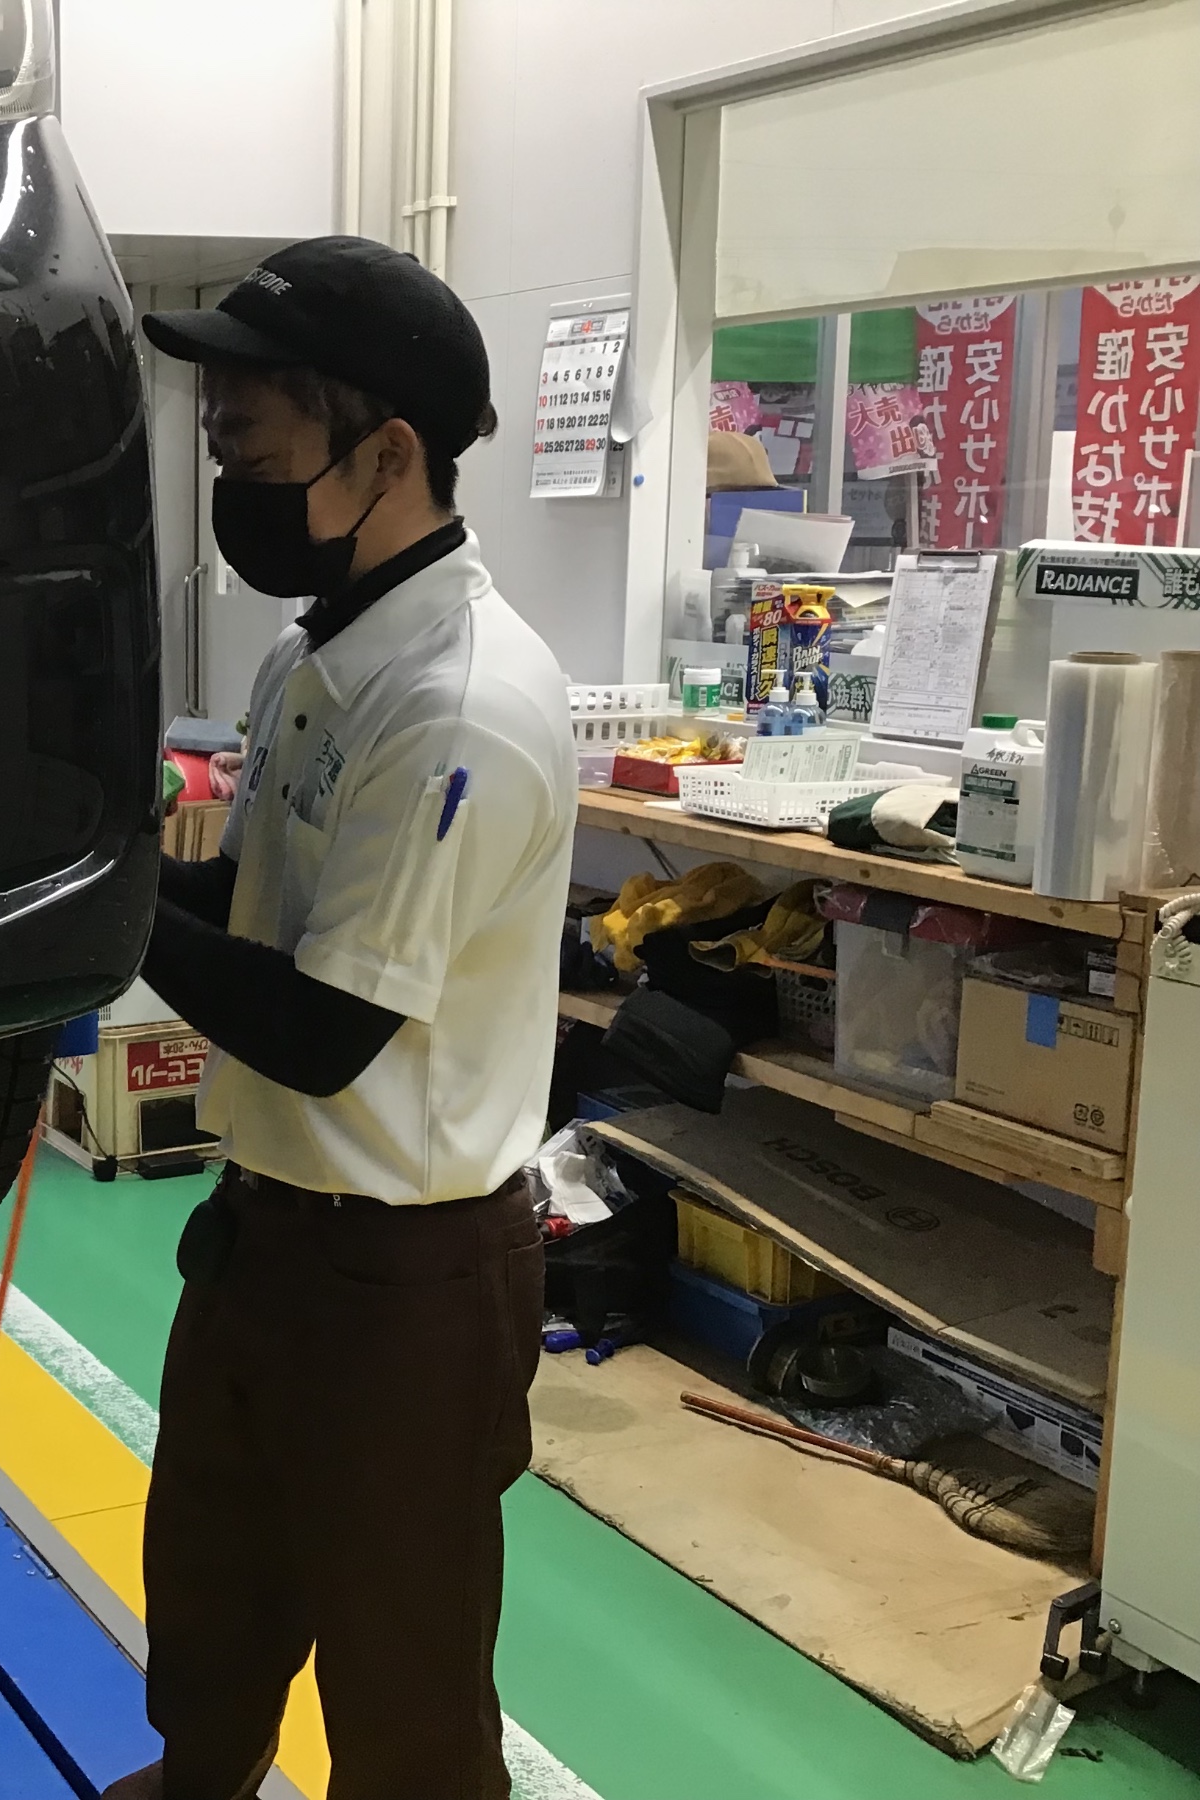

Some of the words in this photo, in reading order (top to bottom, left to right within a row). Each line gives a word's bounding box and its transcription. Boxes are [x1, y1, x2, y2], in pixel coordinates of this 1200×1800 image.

[602, 343, 607, 354] 1
[613, 341, 620, 353] 2
[542, 373, 548, 384] 3
[553, 371, 558, 382] 4
[564, 370, 570, 382] 5
[575, 369, 581, 380] 6
[586, 368, 592, 379] 7
[596, 366, 602, 378] 8
[608, 365, 614, 377] 9
[539, 395, 547, 407] 10
[549, 395, 557, 406] 11
[559, 394, 568, 405] 12
[570, 392, 579, 404] 13
[581, 391, 589, 403] 14
[592, 390, 601, 402] 15
[603, 389, 611, 401] 16
[537, 418, 545, 431] 17
[546, 418, 554, 430] 18
[557, 417, 565, 429] 19
[566, 416, 576, 428] 20
[577, 415, 586, 427] 21
[588, 414, 598, 427] 22
[599, 413, 609, 426] 23
[534, 442, 544, 454] 24
[544, 441, 553, 453] 25
[554, 441, 564, 452] 26
[565, 440, 575, 452] 27
[575, 439, 585, 451] 28
[586, 439, 595, 450] 29
[596, 438, 606, 450] 30
[1040, 569, 1133, 595] RADIANCE
[792, 645, 821, 662] RAIN
[793, 652, 824, 674] DROP
[761, 1137, 887, 1201] BOSCH
